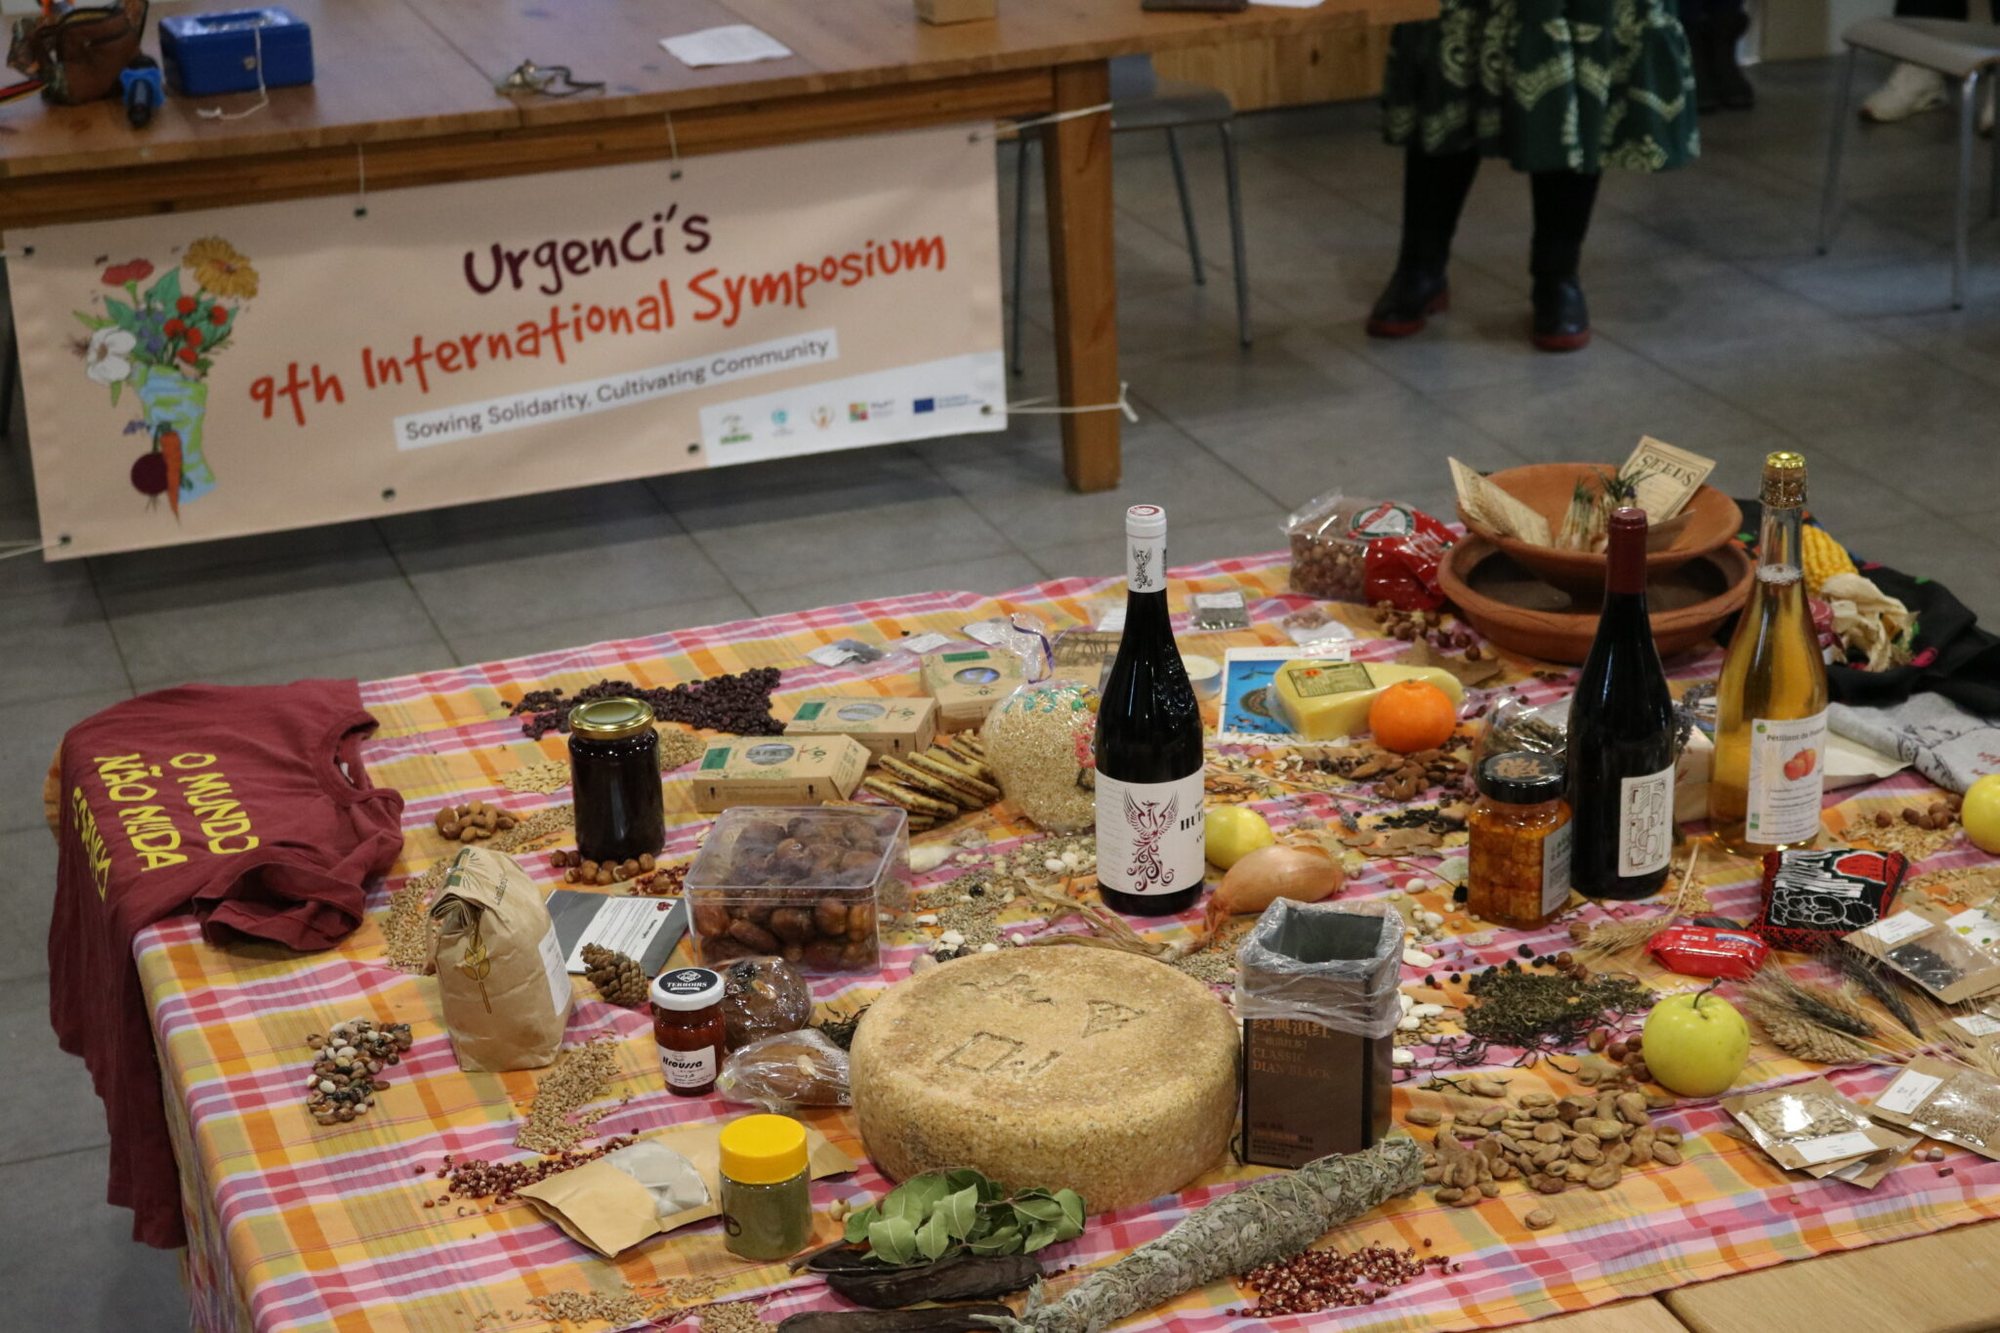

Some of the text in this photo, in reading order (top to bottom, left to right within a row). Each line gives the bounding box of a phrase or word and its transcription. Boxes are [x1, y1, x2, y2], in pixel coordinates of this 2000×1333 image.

[250, 235, 946, 427] 9th International Symposium
[405, 338, 829, 441] Sowing Solidarity, Cultivating Community
[94, 753, 188, 872] NÃO MUDA
[169, 752, 260, 855] O MUNDO
[666, 981, 708, 989] TERROIRS
[1252, 1047, 1306, 1063] CLASSIC
